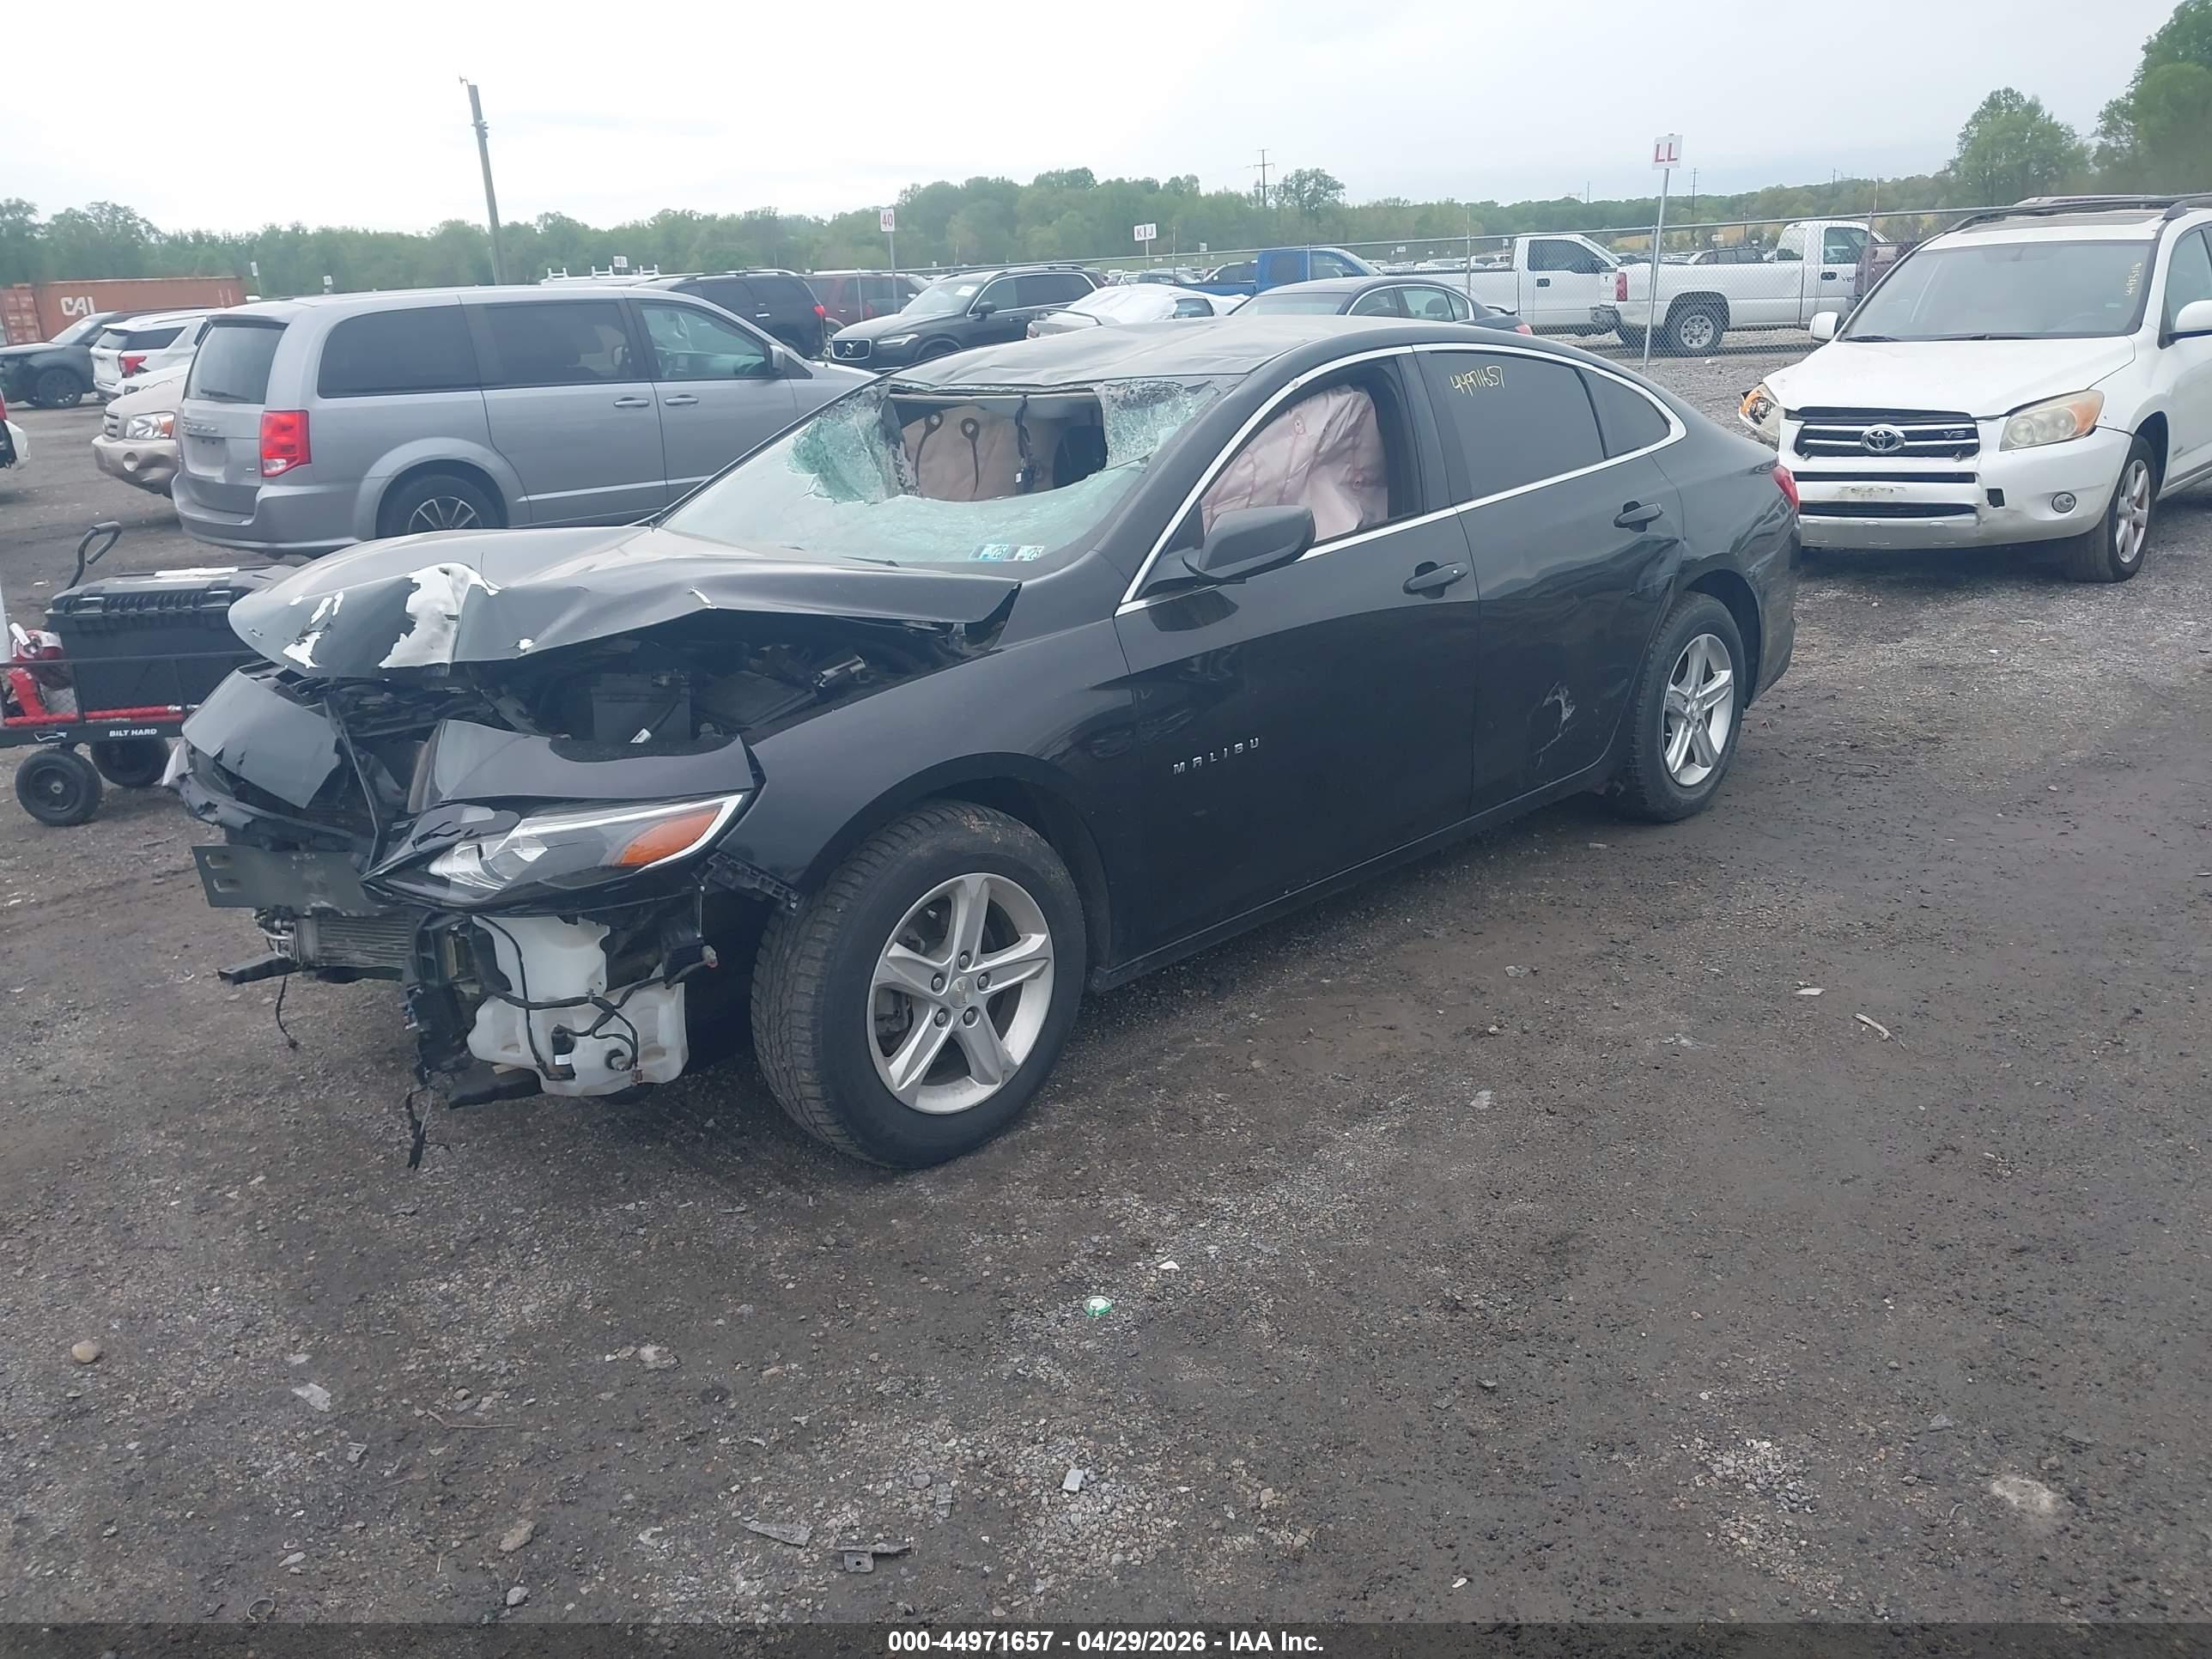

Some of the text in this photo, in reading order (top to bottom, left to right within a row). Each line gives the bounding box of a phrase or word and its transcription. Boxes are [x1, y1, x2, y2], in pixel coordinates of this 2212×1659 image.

[1654, 143, 1678, 163] LL
[882, 214, 894, 227] 40
[60, 296, 96, 316] CAI
[1449, 365, 1505, 397] 44971657
[109, 729, 130, 738] BILT
[1173, 738, 1259, 775] MALIBU
